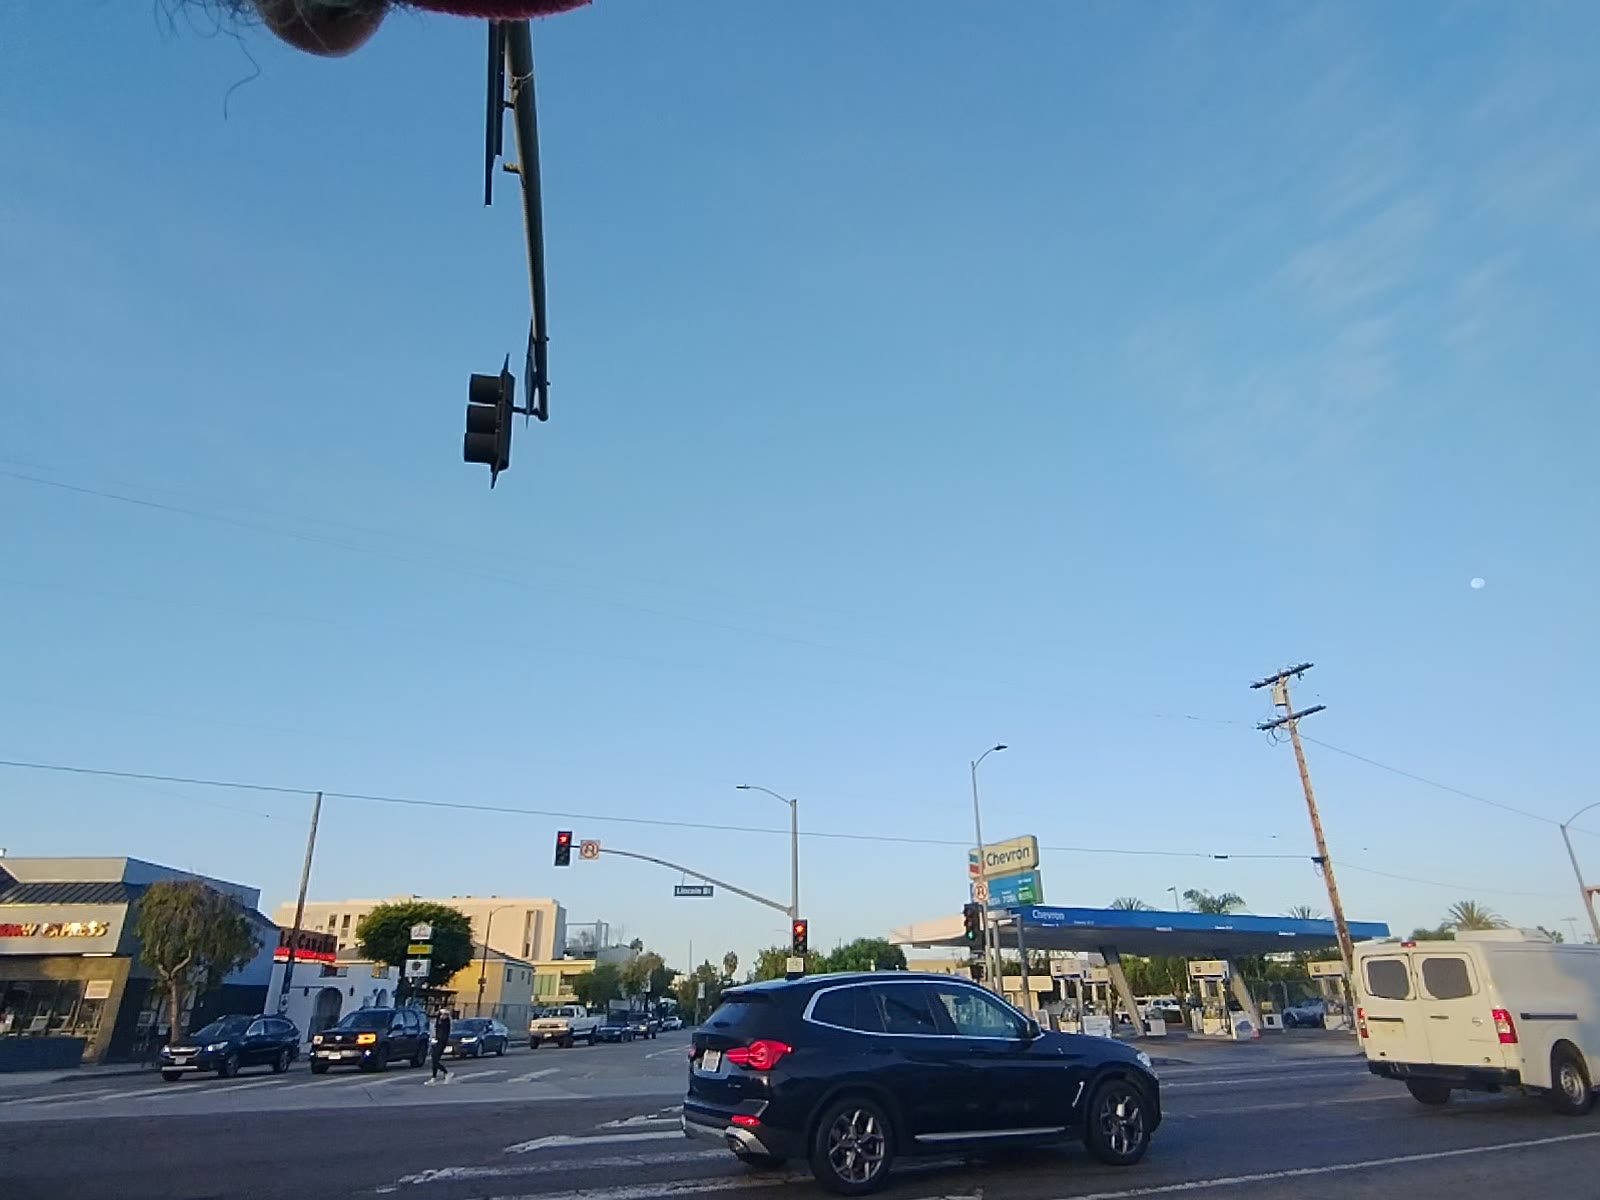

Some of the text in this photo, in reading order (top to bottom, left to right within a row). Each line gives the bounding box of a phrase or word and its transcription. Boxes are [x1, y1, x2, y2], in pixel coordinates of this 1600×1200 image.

[986, 846, 1030, 867] Chevron
[1032, 909, 1065, 921] Chevron
[41, 921, 110, 938] EXPRESS
